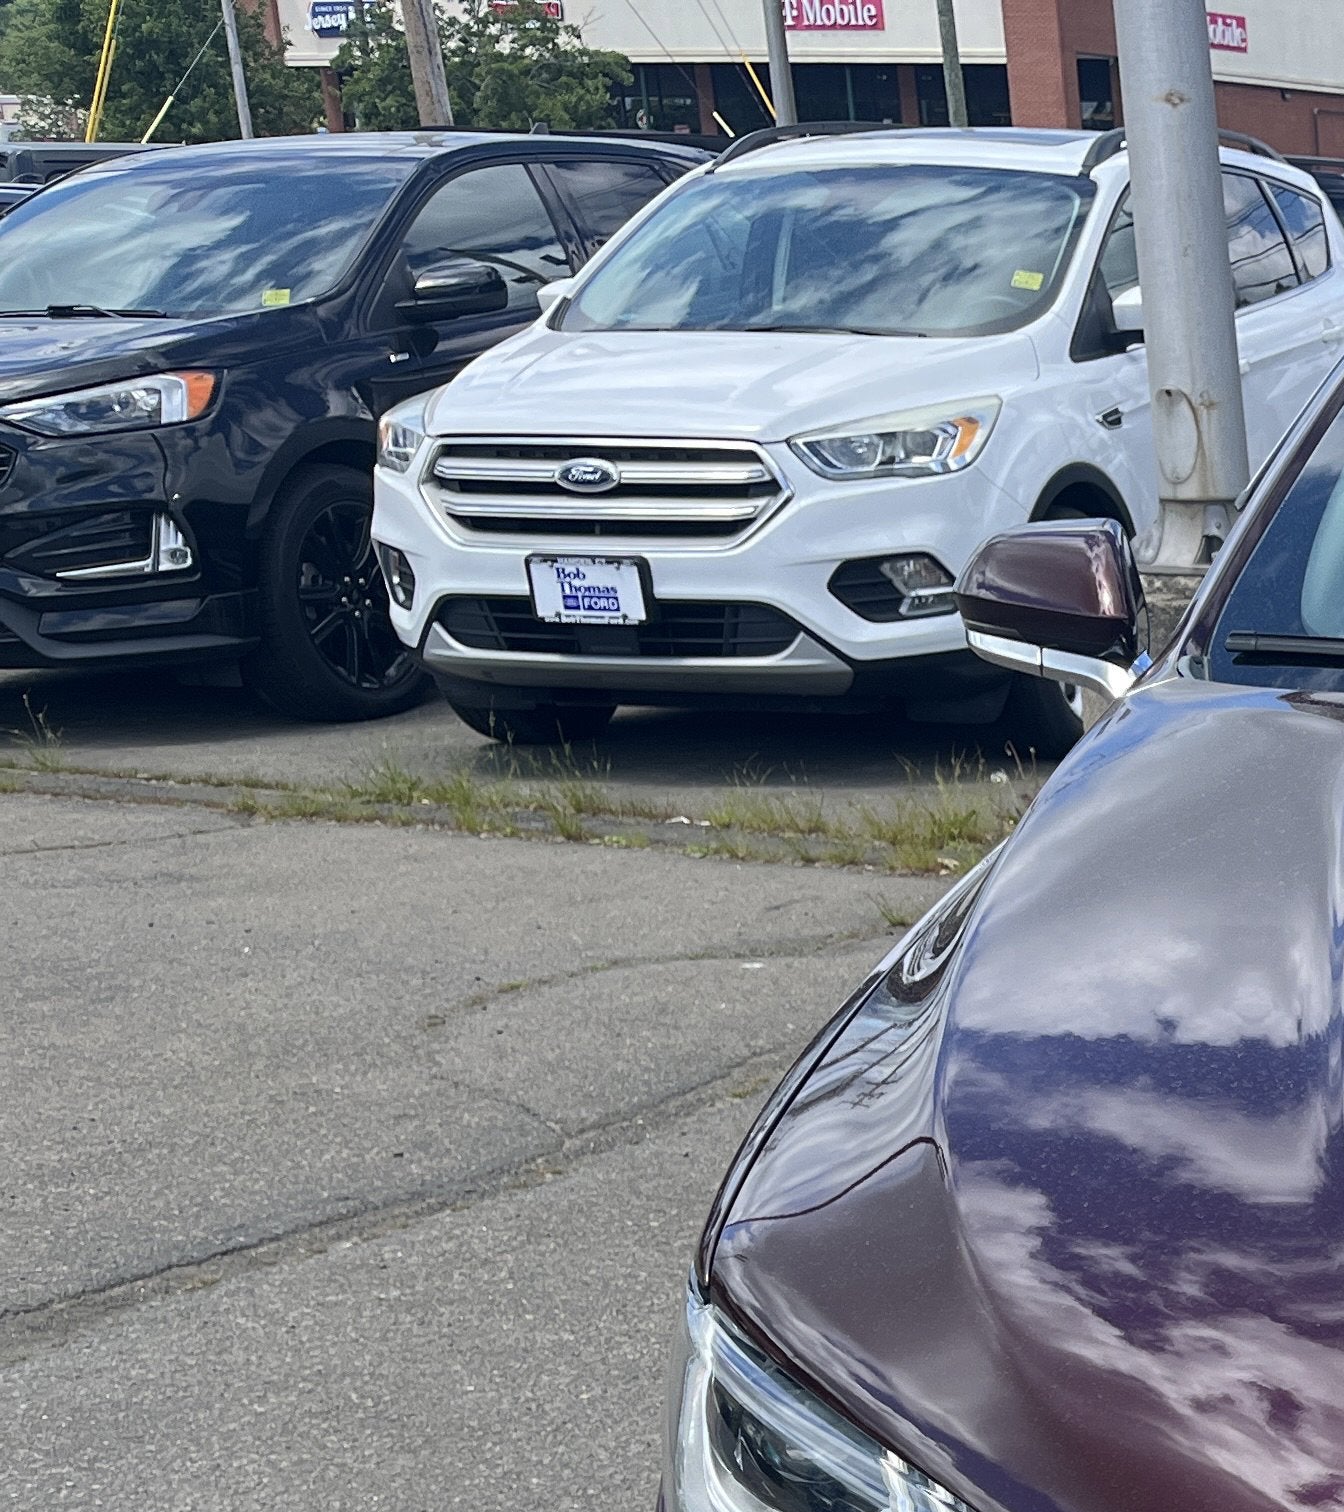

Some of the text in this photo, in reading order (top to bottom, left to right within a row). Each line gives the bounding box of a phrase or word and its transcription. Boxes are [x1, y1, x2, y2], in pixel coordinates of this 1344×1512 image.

[801, 0, 877, 26] Mobile
[304, 12, 348, 31] Jersey
[1207, 15, 1247, 47] obile
[568, 466, 602, 482] Ford
[556, 567, 586, 581] Bob
[557, 580, 618, 595] Thomas
[583, 597, 618, 610] FORD
